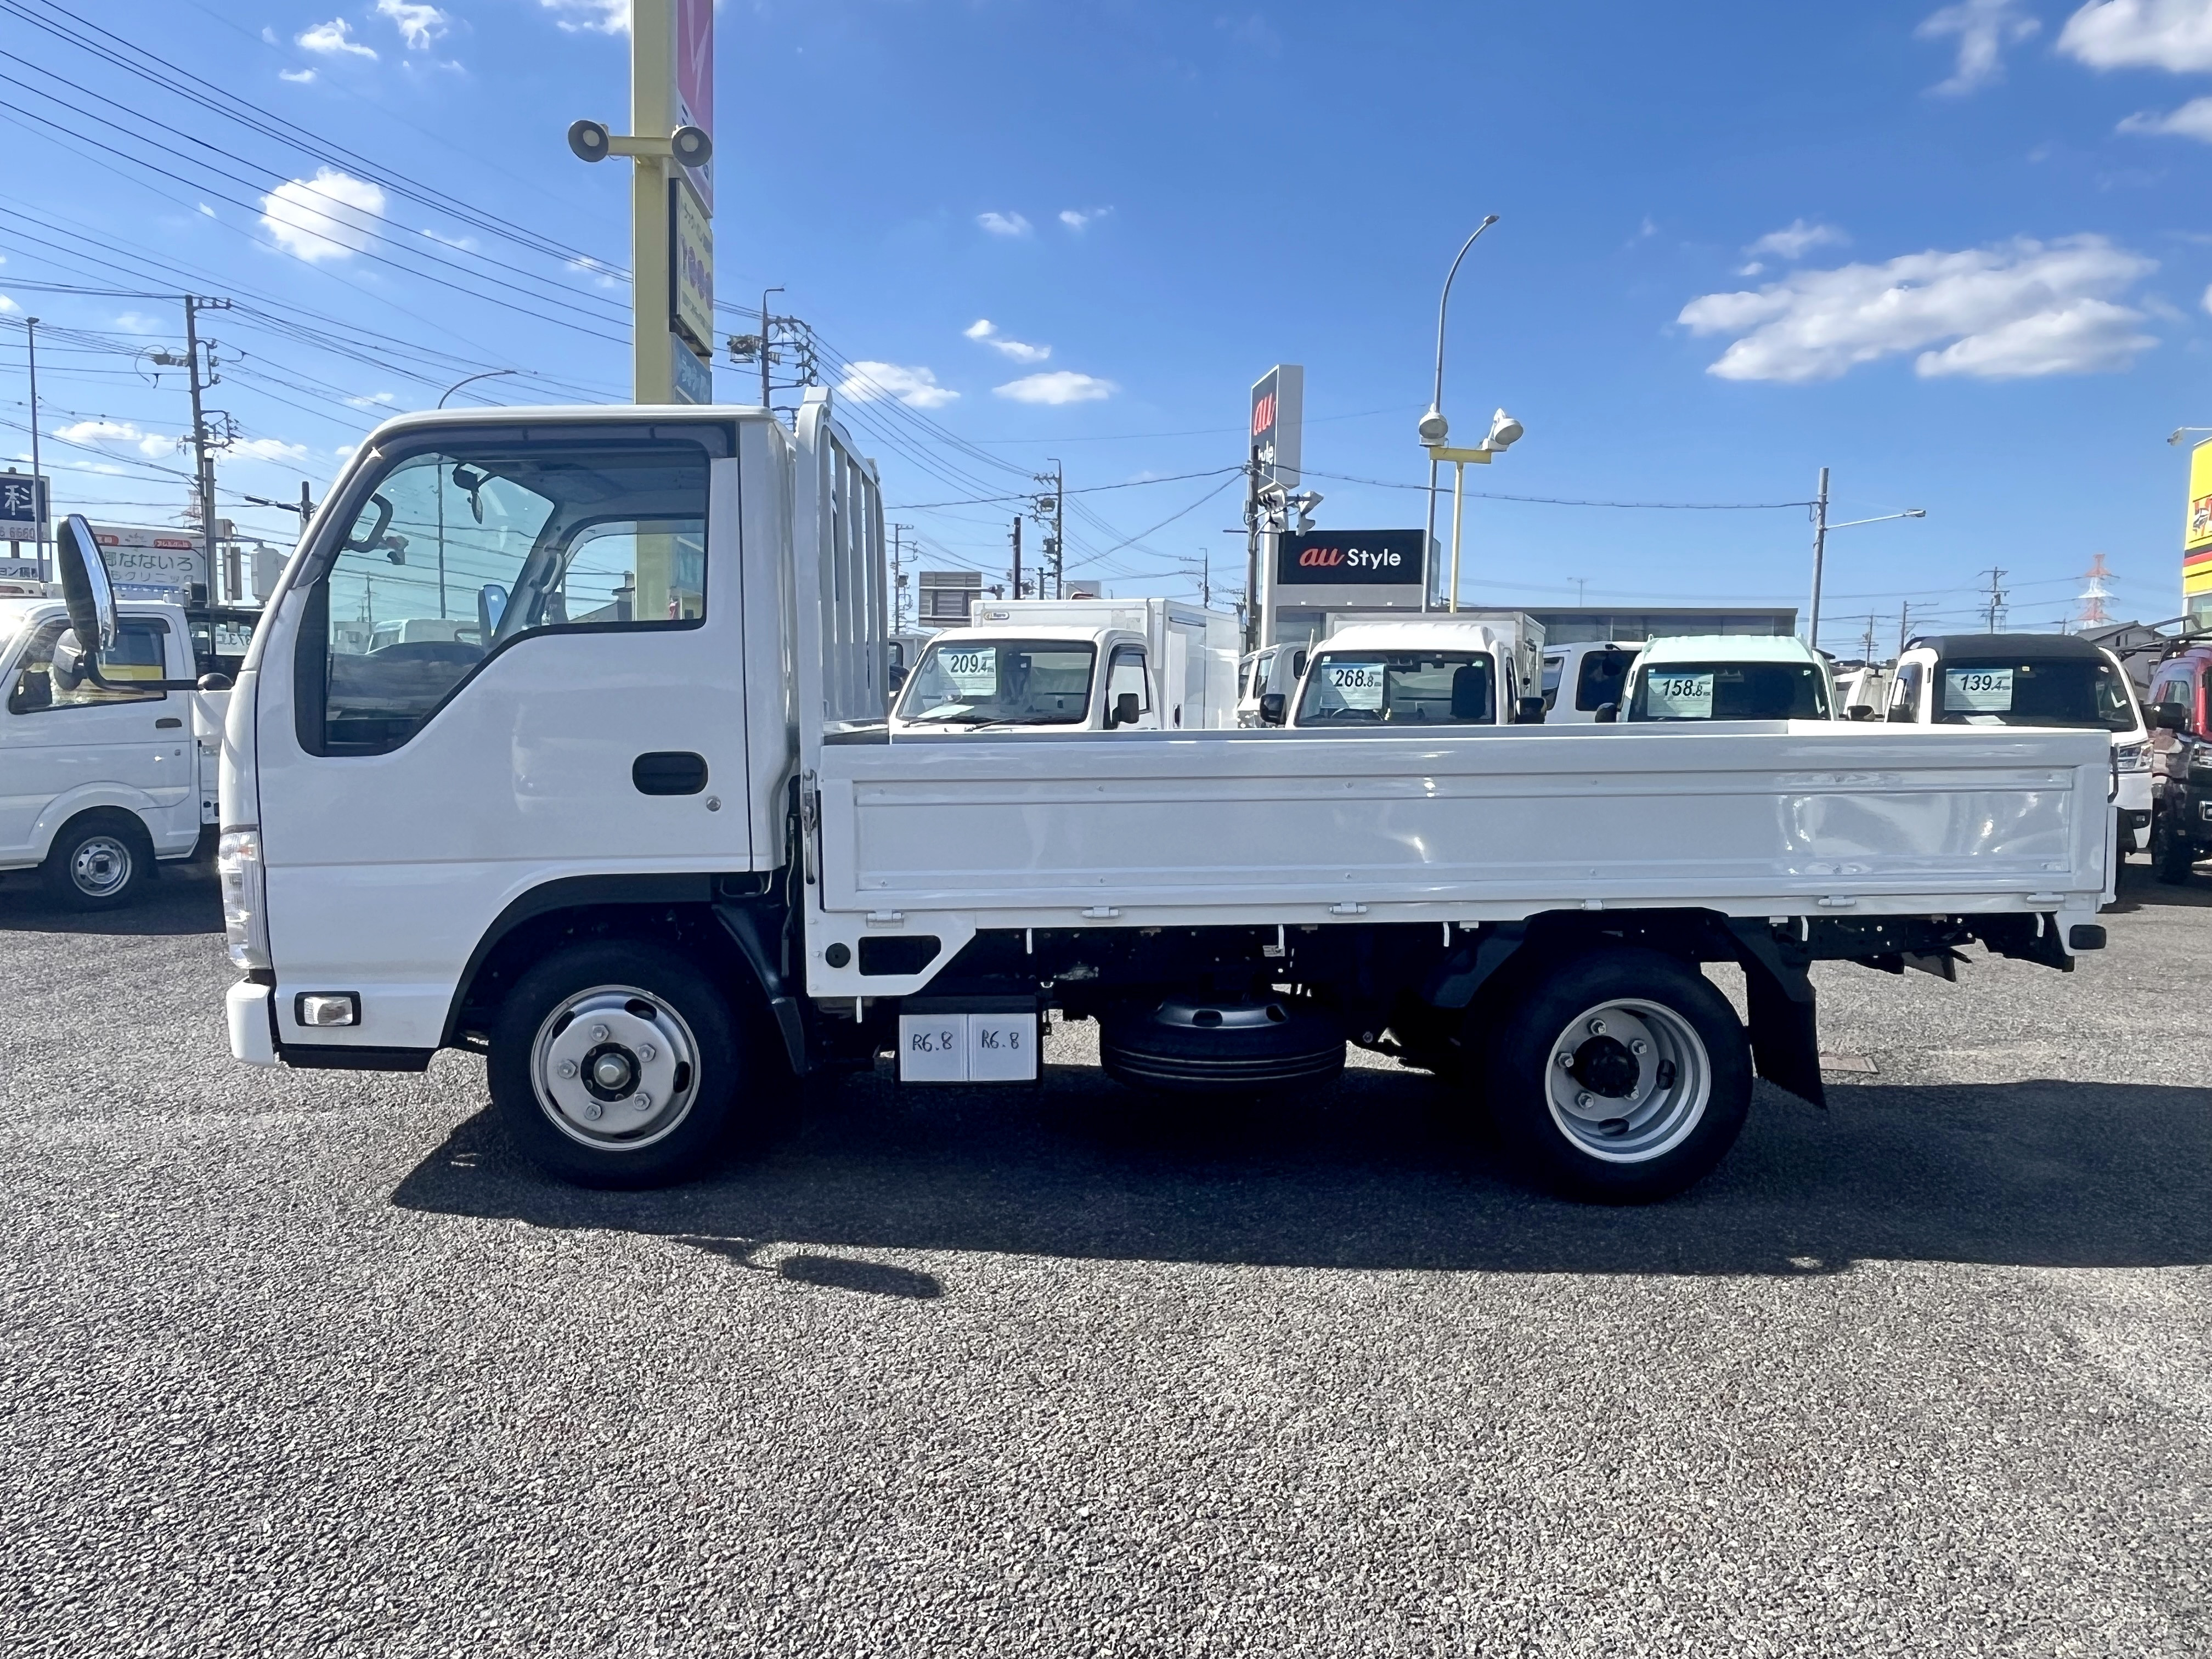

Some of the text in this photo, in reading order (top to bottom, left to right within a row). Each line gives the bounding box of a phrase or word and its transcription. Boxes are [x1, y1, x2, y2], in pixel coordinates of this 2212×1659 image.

[1254, 392, 1276, 436] au
[1299, 548, 1401, 569] au Style
[1334, 669, 1374, 687] 268.8
[1662, 679, 1703, 696] 158.8
[912, 1031, 953, 1052] R6.8
